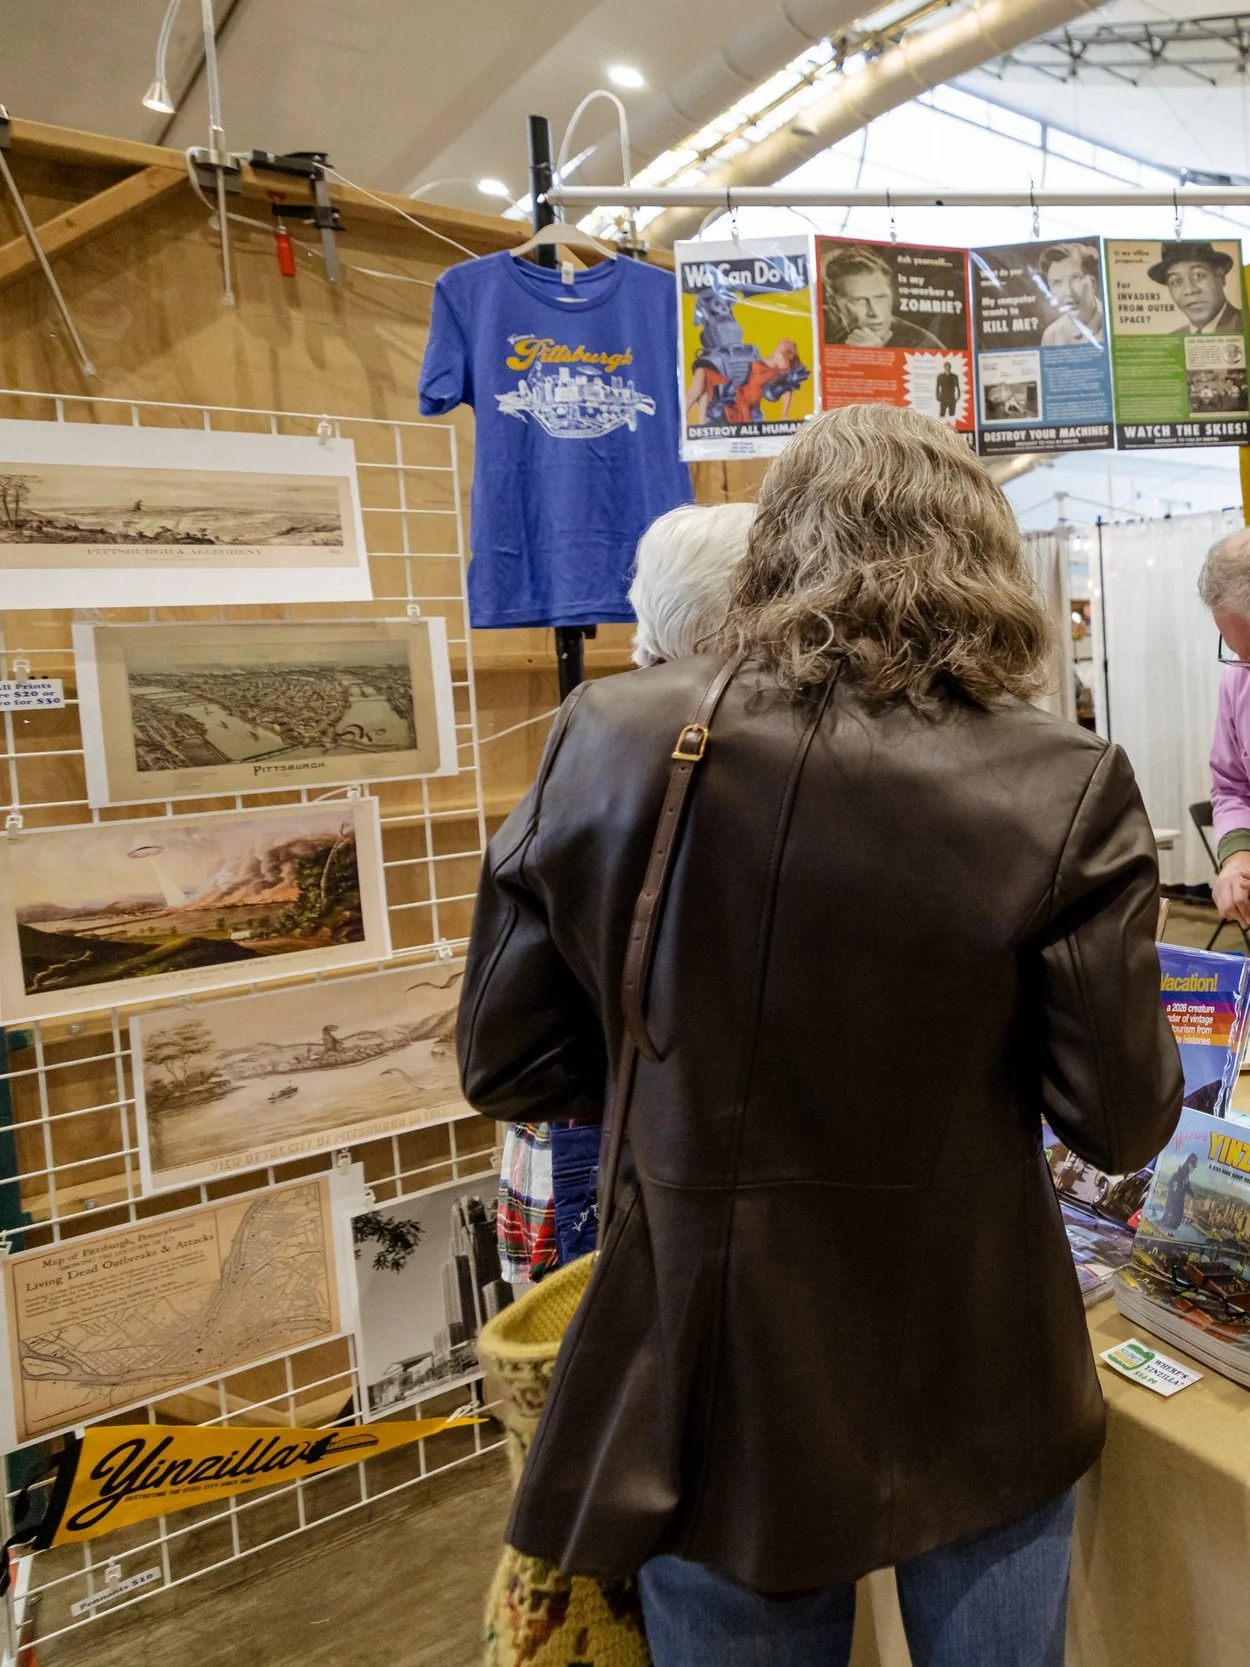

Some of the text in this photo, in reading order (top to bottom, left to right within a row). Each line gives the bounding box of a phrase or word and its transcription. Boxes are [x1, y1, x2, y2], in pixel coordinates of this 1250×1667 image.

[897, 255, 911, 264] Ask
[684, 260, 781, 288] We Can Do
[910, 276, 925, 287] my
[1117, 281, 1130, 289] For
[982, 297, 996, 308] My
[1118, 292, 1160, 301] INVADERS
[900, 298, 963, 314] ZOMBIE?
[982, 307, 1019, 316] wants to
[1119, 303, 1175, 312] FROM OUTER
[983, 317, 1039, 333] KILL ME?
[1120, 315, 1151, 324] SPACE?
[506, 338, 633, 373] Pittsburgh
[689, 425, 759, 438] DESTROY ALL
[984, 431, 1026, 442] DESTROY
[1029, 429, 1057, 441] YOUR
[1059, 425, 1109, 438] MACHINES
[1124, 422, 1247, 437] WATCH THE SKIES!
[1160, 972, 1218, 992] Vacation!
[1166, 1003, 1215, 1013] a 2026 creature
[1182, 1014, 1213, 1025] of vintage
[1172, 1024, 1212, 1034] tourism from
[1183, 1035, 1210, 1045] histories
[1222, 1167, 1231, 1176] BOOK
[1232, 1171, 1244, 1181] ABOUT
[42, 1222, 195, 1269] Map of Pittsburgh, Pennsylvania
[26, 1234, 214, 1292] Living Dead Outbreaks & Attacks
[1144, 1365, 1185, 1386] YINZILLA?
[1154, 1360, 1189, 1379] WHERE'S
[66, 1437, 312, 1531] Yinzilla
[80, 1573, 153, 1609] Pennants $10
